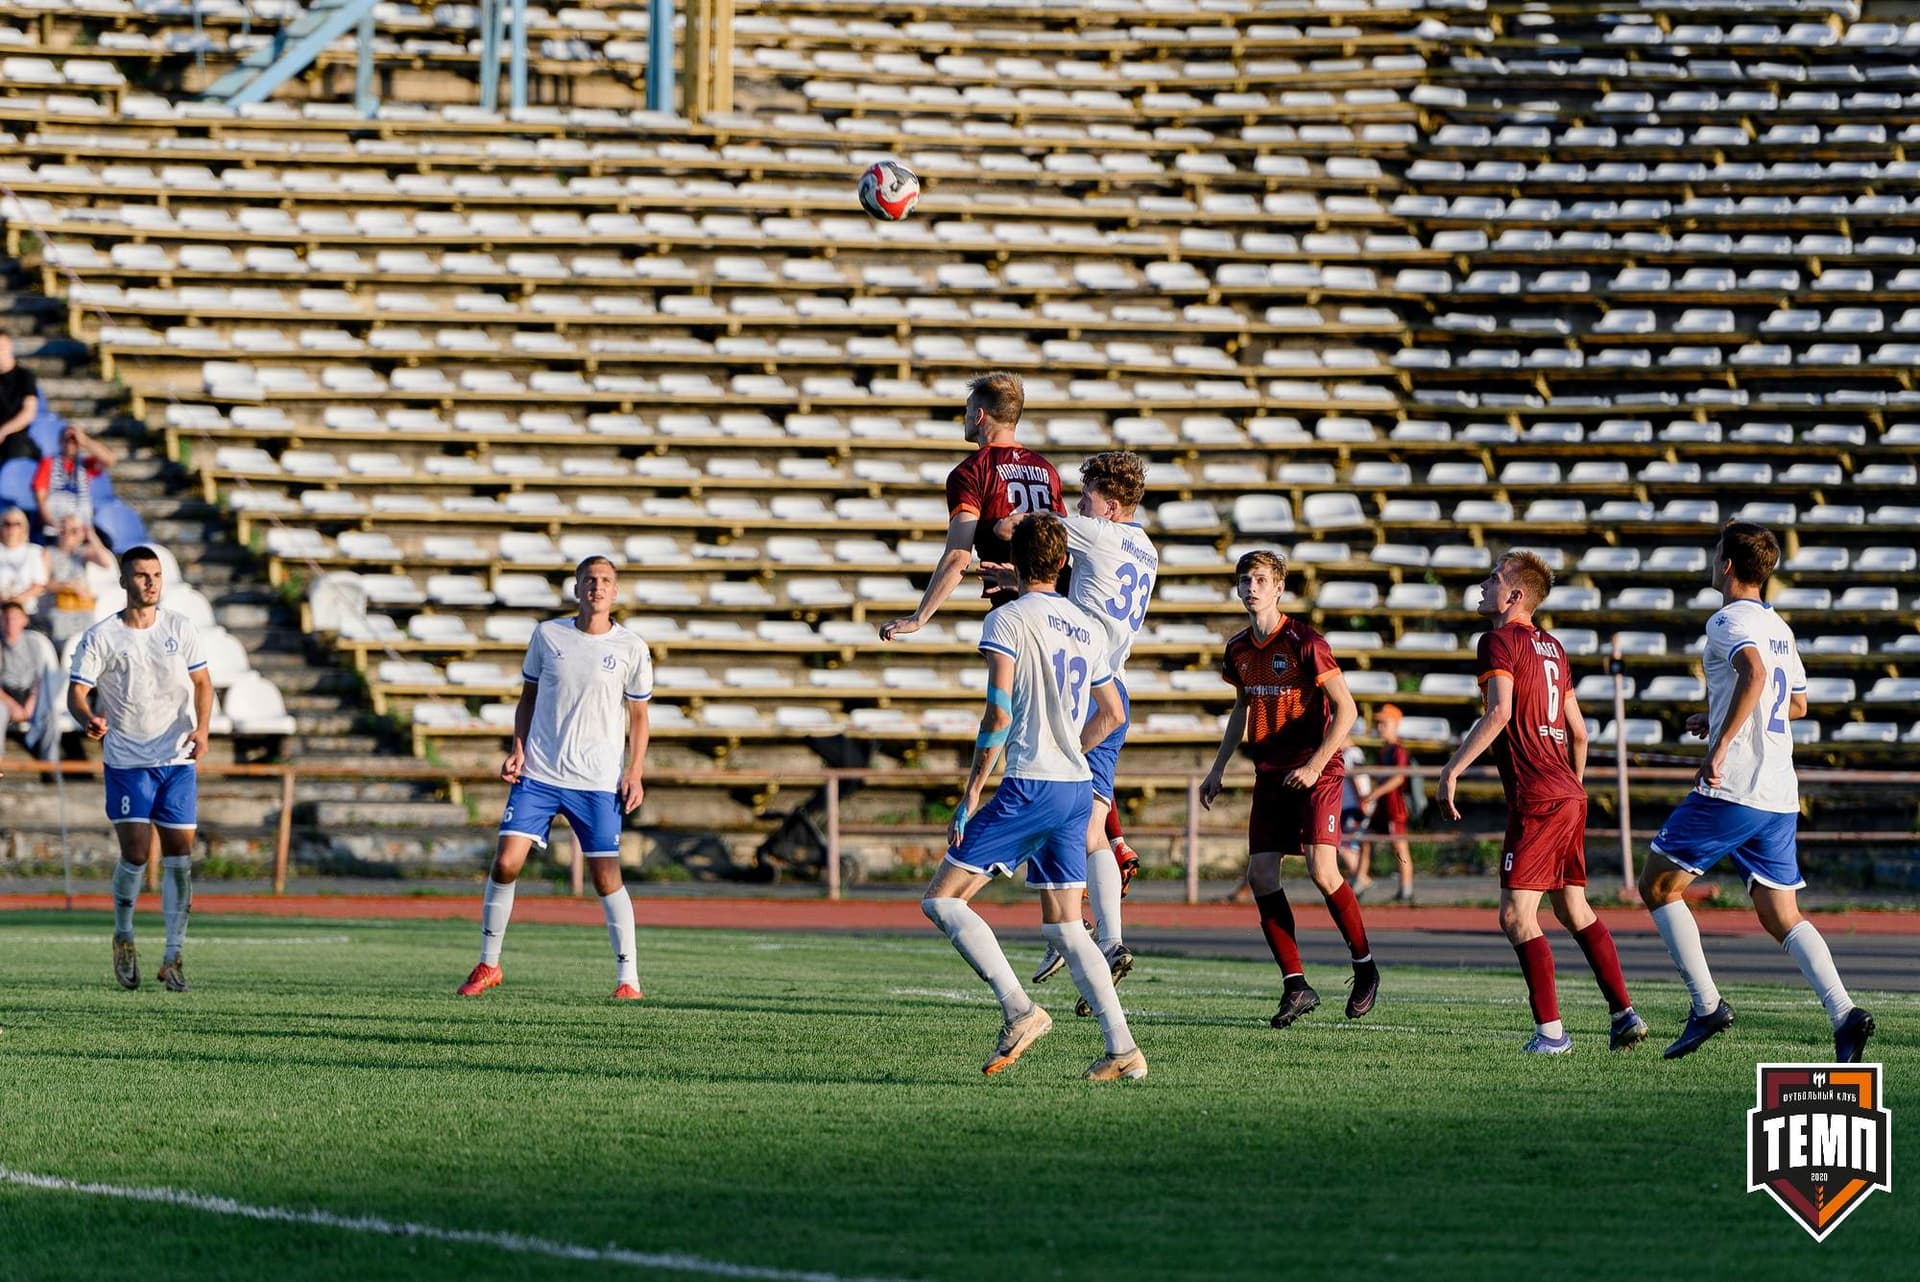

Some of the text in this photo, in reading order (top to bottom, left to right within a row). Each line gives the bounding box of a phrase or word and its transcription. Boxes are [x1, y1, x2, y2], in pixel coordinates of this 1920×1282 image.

[1105, 562, 1151, 632] 33
[1052, 648, 1087, 722] 13
[1543, 660, 1559, 723] 6
[1767, 667, 1787, 734] 2
[121, 795, 130, 815] 8
[1328, 814, 1335, 833] 3
[1504, 852, 1514, 871] 6
